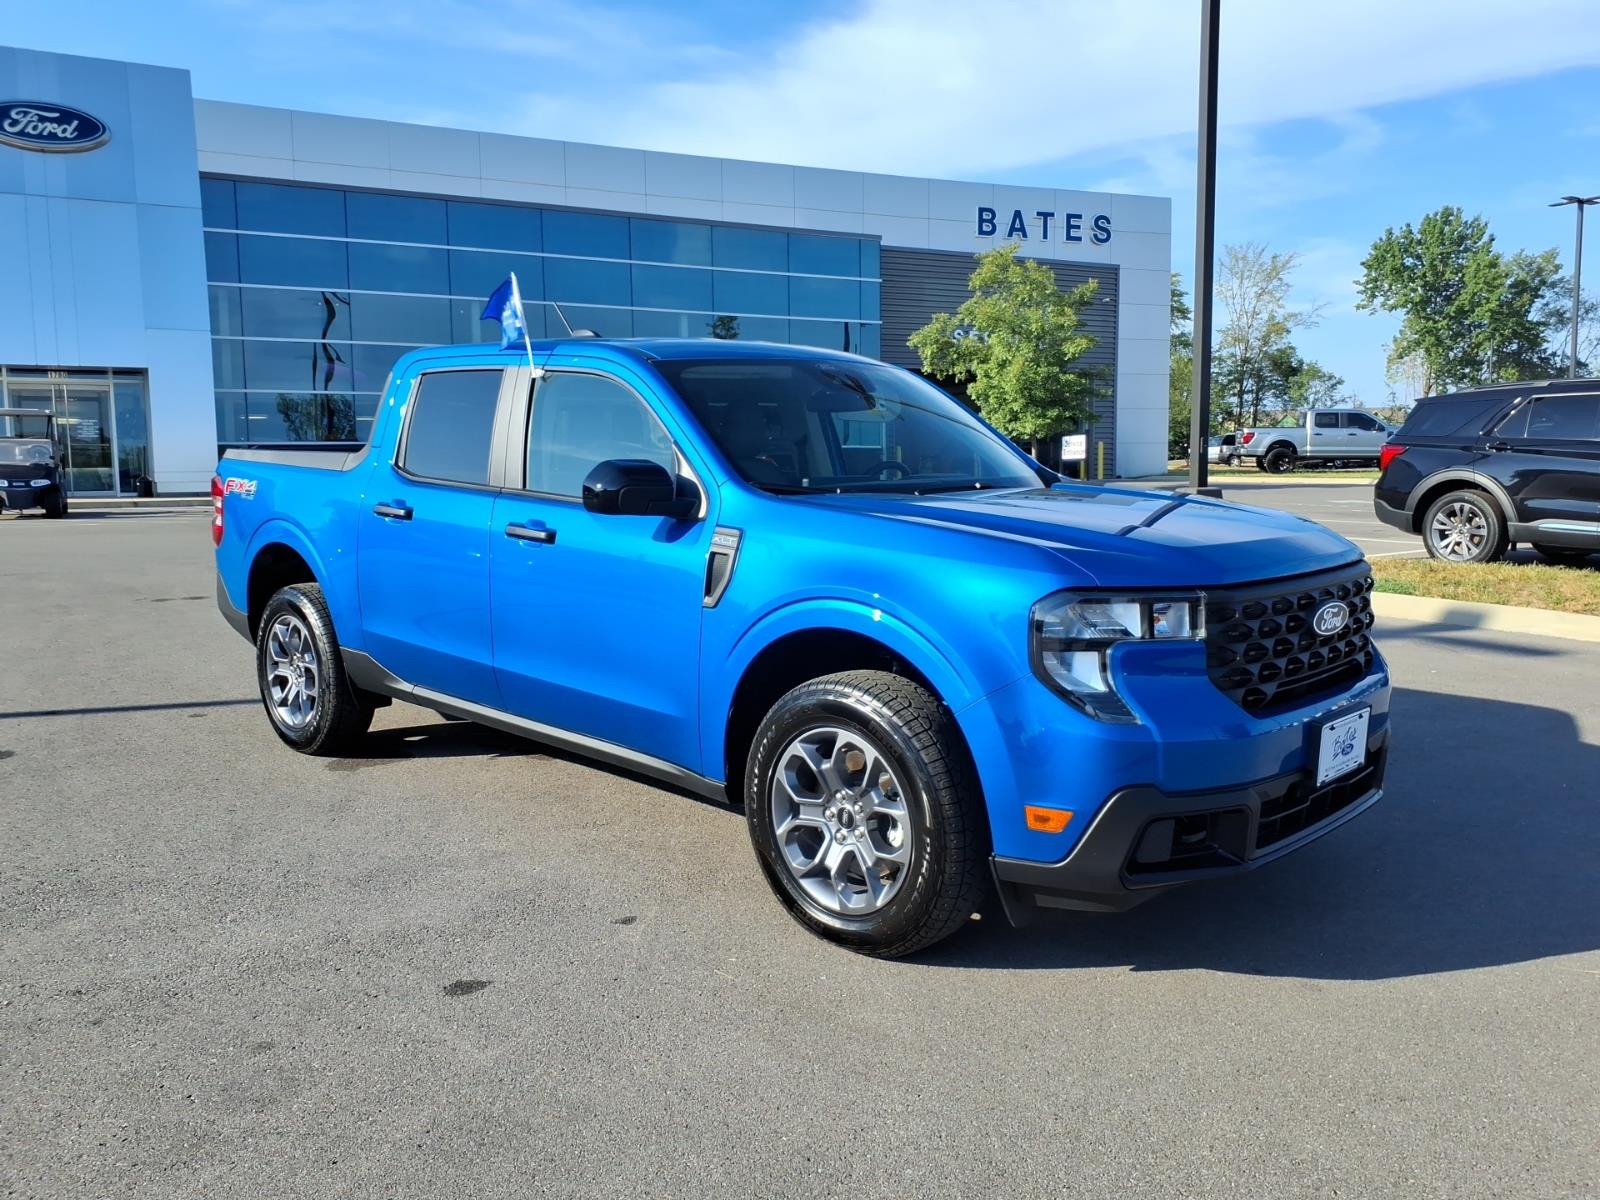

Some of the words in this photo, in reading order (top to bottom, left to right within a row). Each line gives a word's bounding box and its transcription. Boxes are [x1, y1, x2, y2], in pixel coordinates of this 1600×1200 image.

[3, 107, 79, 139] Ford
[977, 206, 1112, 244] BATES
[224, 478, 258, 496] FX4
[1320, 607, 1344, 631] Ford
